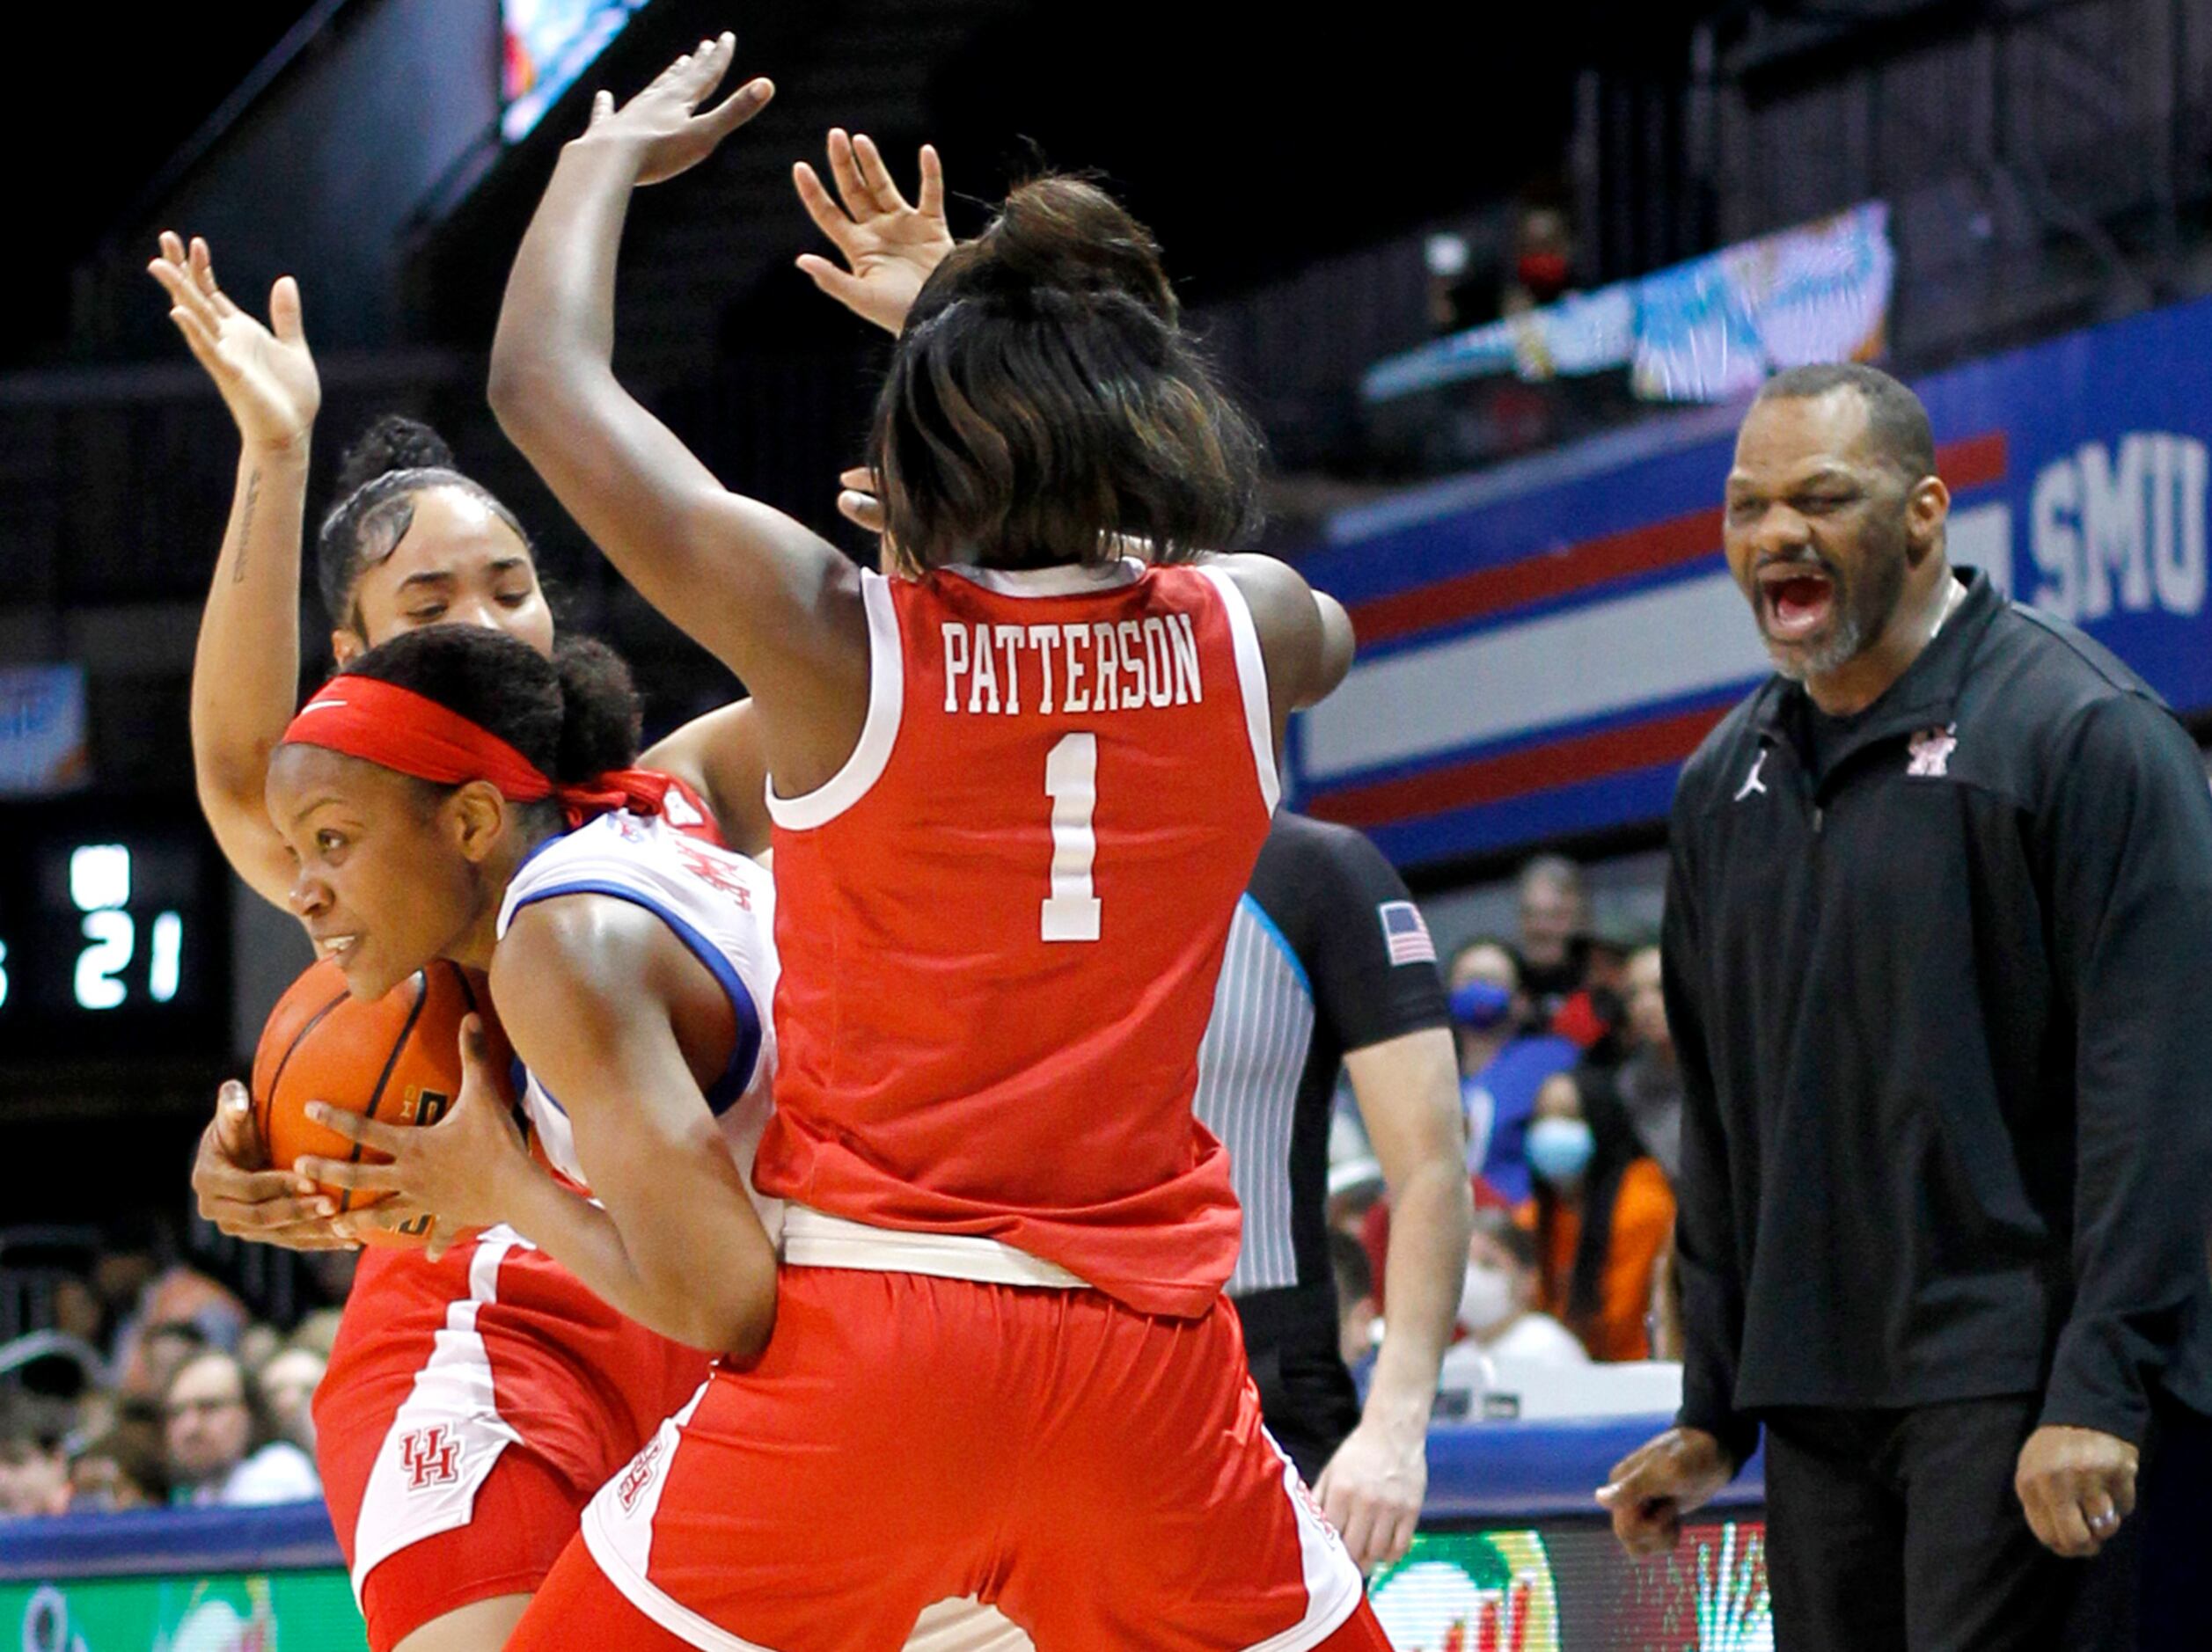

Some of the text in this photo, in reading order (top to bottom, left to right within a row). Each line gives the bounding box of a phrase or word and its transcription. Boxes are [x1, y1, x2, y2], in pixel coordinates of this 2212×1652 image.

[2031, 435, 2207, 620] SMU
[941, 613, 1202, 714] PATTERSON
[1041, 732, 1102, 942] 1
[74, 909, 182, 1009] 21
[401, 1425, 458, 1488] UH
